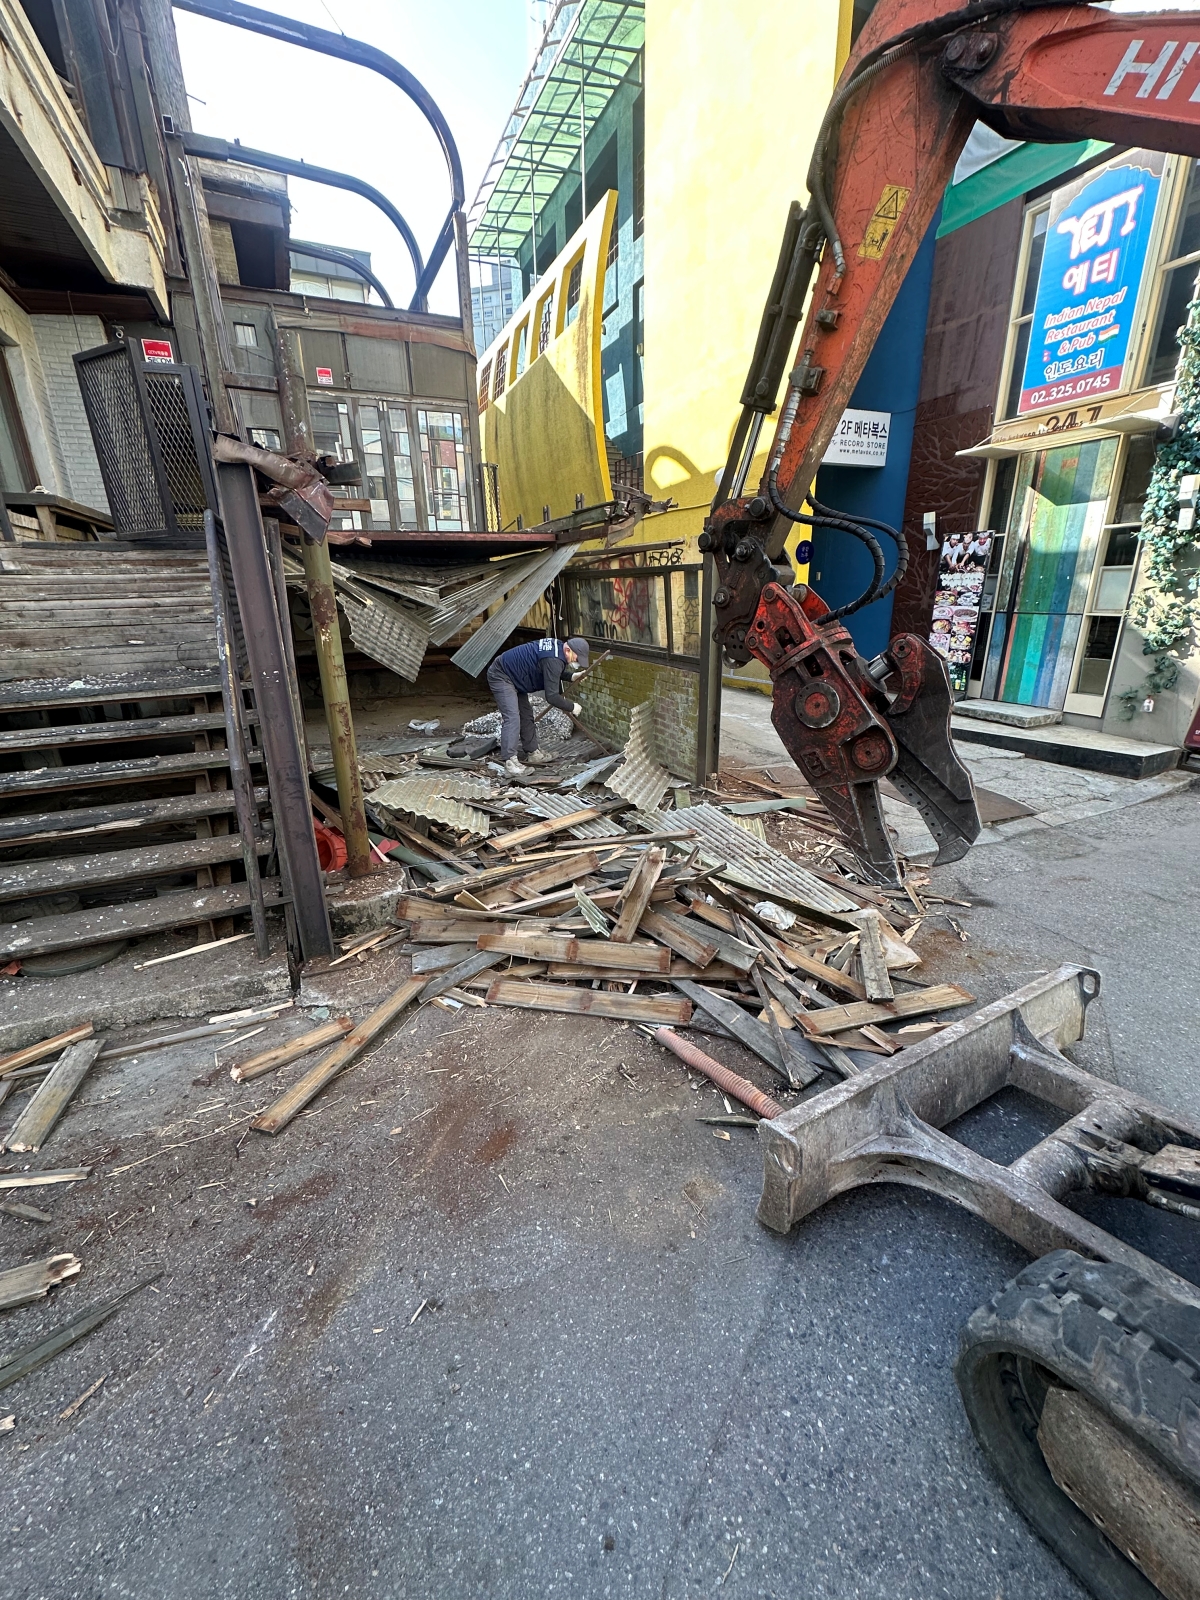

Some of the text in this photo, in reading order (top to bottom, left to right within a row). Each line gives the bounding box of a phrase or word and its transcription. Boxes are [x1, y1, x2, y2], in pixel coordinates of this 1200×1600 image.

[1062, 248, 1120, 295] 예티
[1044, 286, 1128, 329] Indian Nepal
[1044, 309, 1116, 345] Restaurant
[1058, 332, 1096, 356] & Pub
[1044, 348, 1105, 381] 인도요리
[1030, 373, 1111, 404] 02.325.0745
[839, 439, 865, 448] RECORD
[866, 441, 886, 450] STORE
[840, 420, 853, 435] 2F
[854, 420, 888, 440] 메타복스
